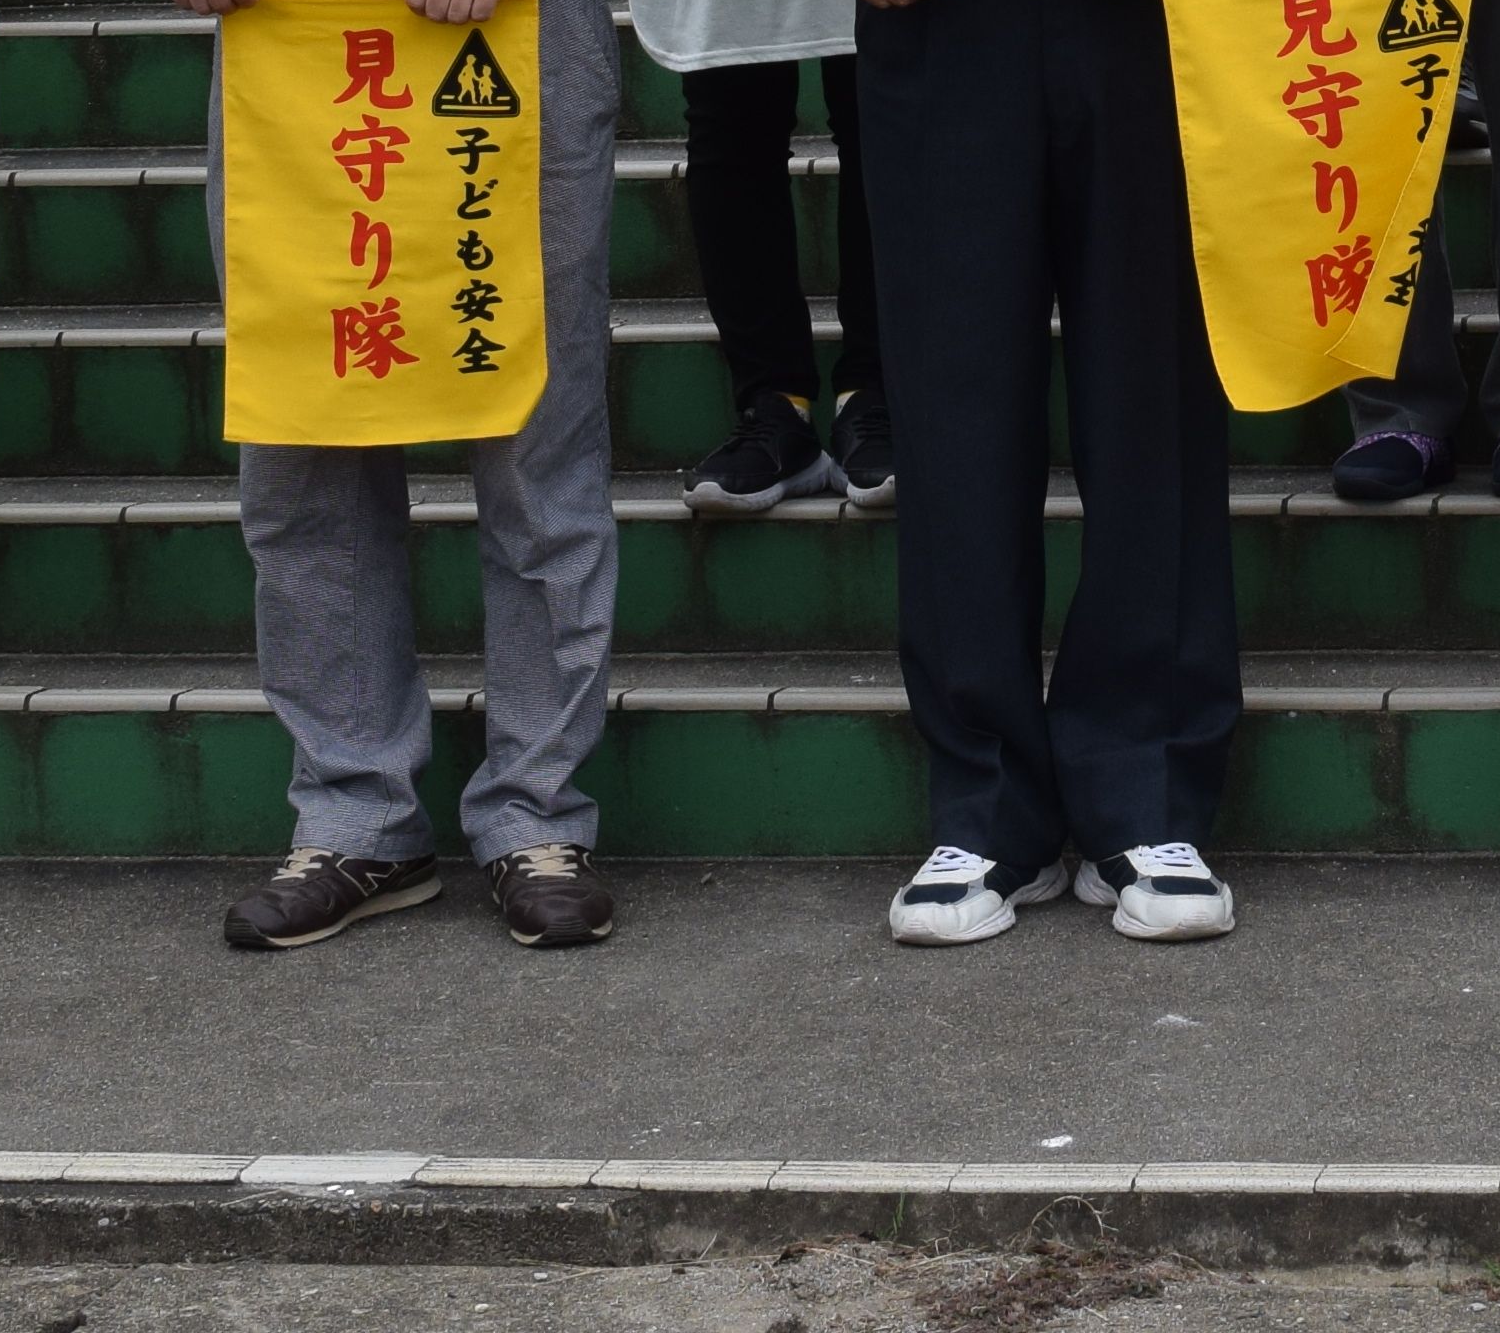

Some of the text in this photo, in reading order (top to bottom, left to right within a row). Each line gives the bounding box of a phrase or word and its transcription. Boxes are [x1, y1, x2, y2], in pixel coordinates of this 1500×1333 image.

[331, 27, 421, 380] 見守り隊
[446, 126, 507, 375] 子ども安全
